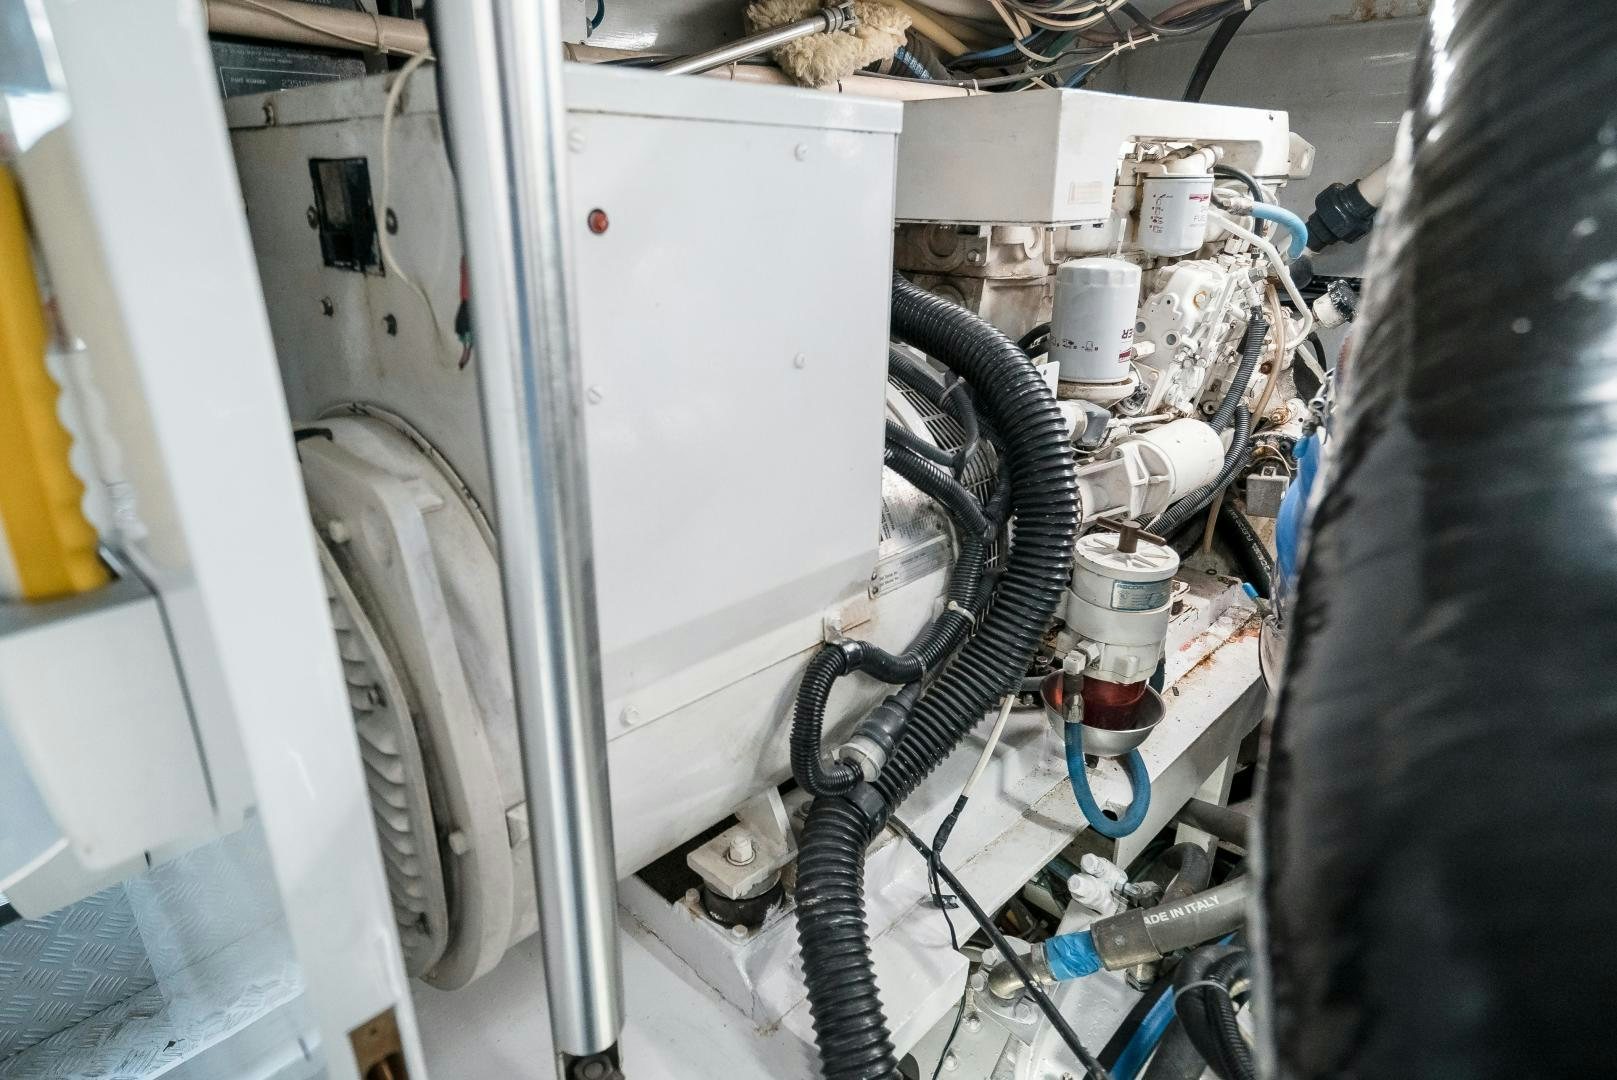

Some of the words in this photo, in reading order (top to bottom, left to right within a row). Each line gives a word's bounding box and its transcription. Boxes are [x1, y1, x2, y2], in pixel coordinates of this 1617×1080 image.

[1143, 911, 1170, 925] ADE
[1169, 907, 1185, 919] IN
[1184, 895, 1220, 914] ITALY
